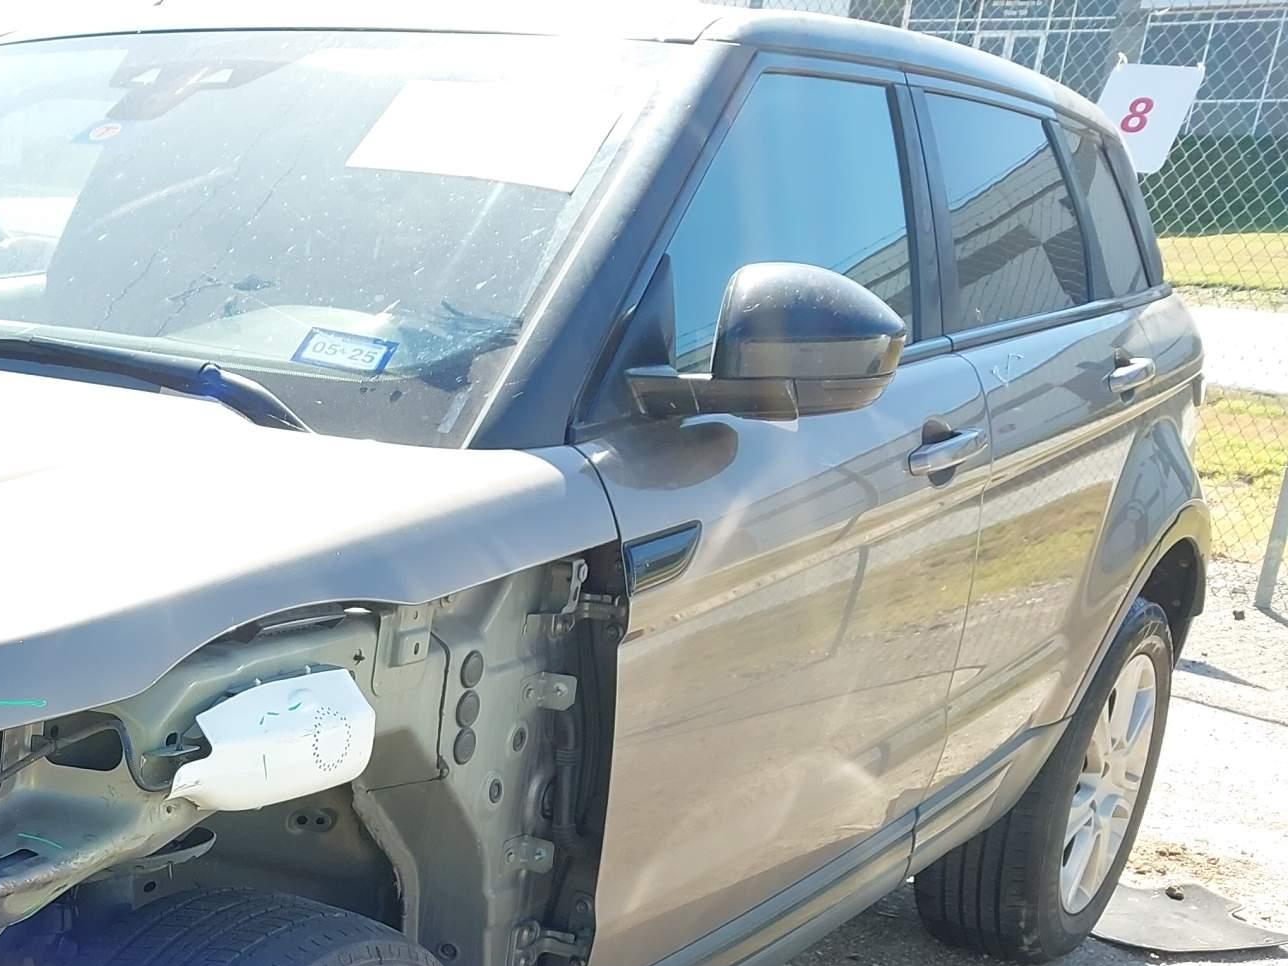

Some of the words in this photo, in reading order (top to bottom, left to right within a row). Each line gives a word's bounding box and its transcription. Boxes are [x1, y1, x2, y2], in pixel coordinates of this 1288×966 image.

[1120, 97, 1154, 133] 8
[312, 341, 341, 356] 05
[347, 347, 378, 364] 25
